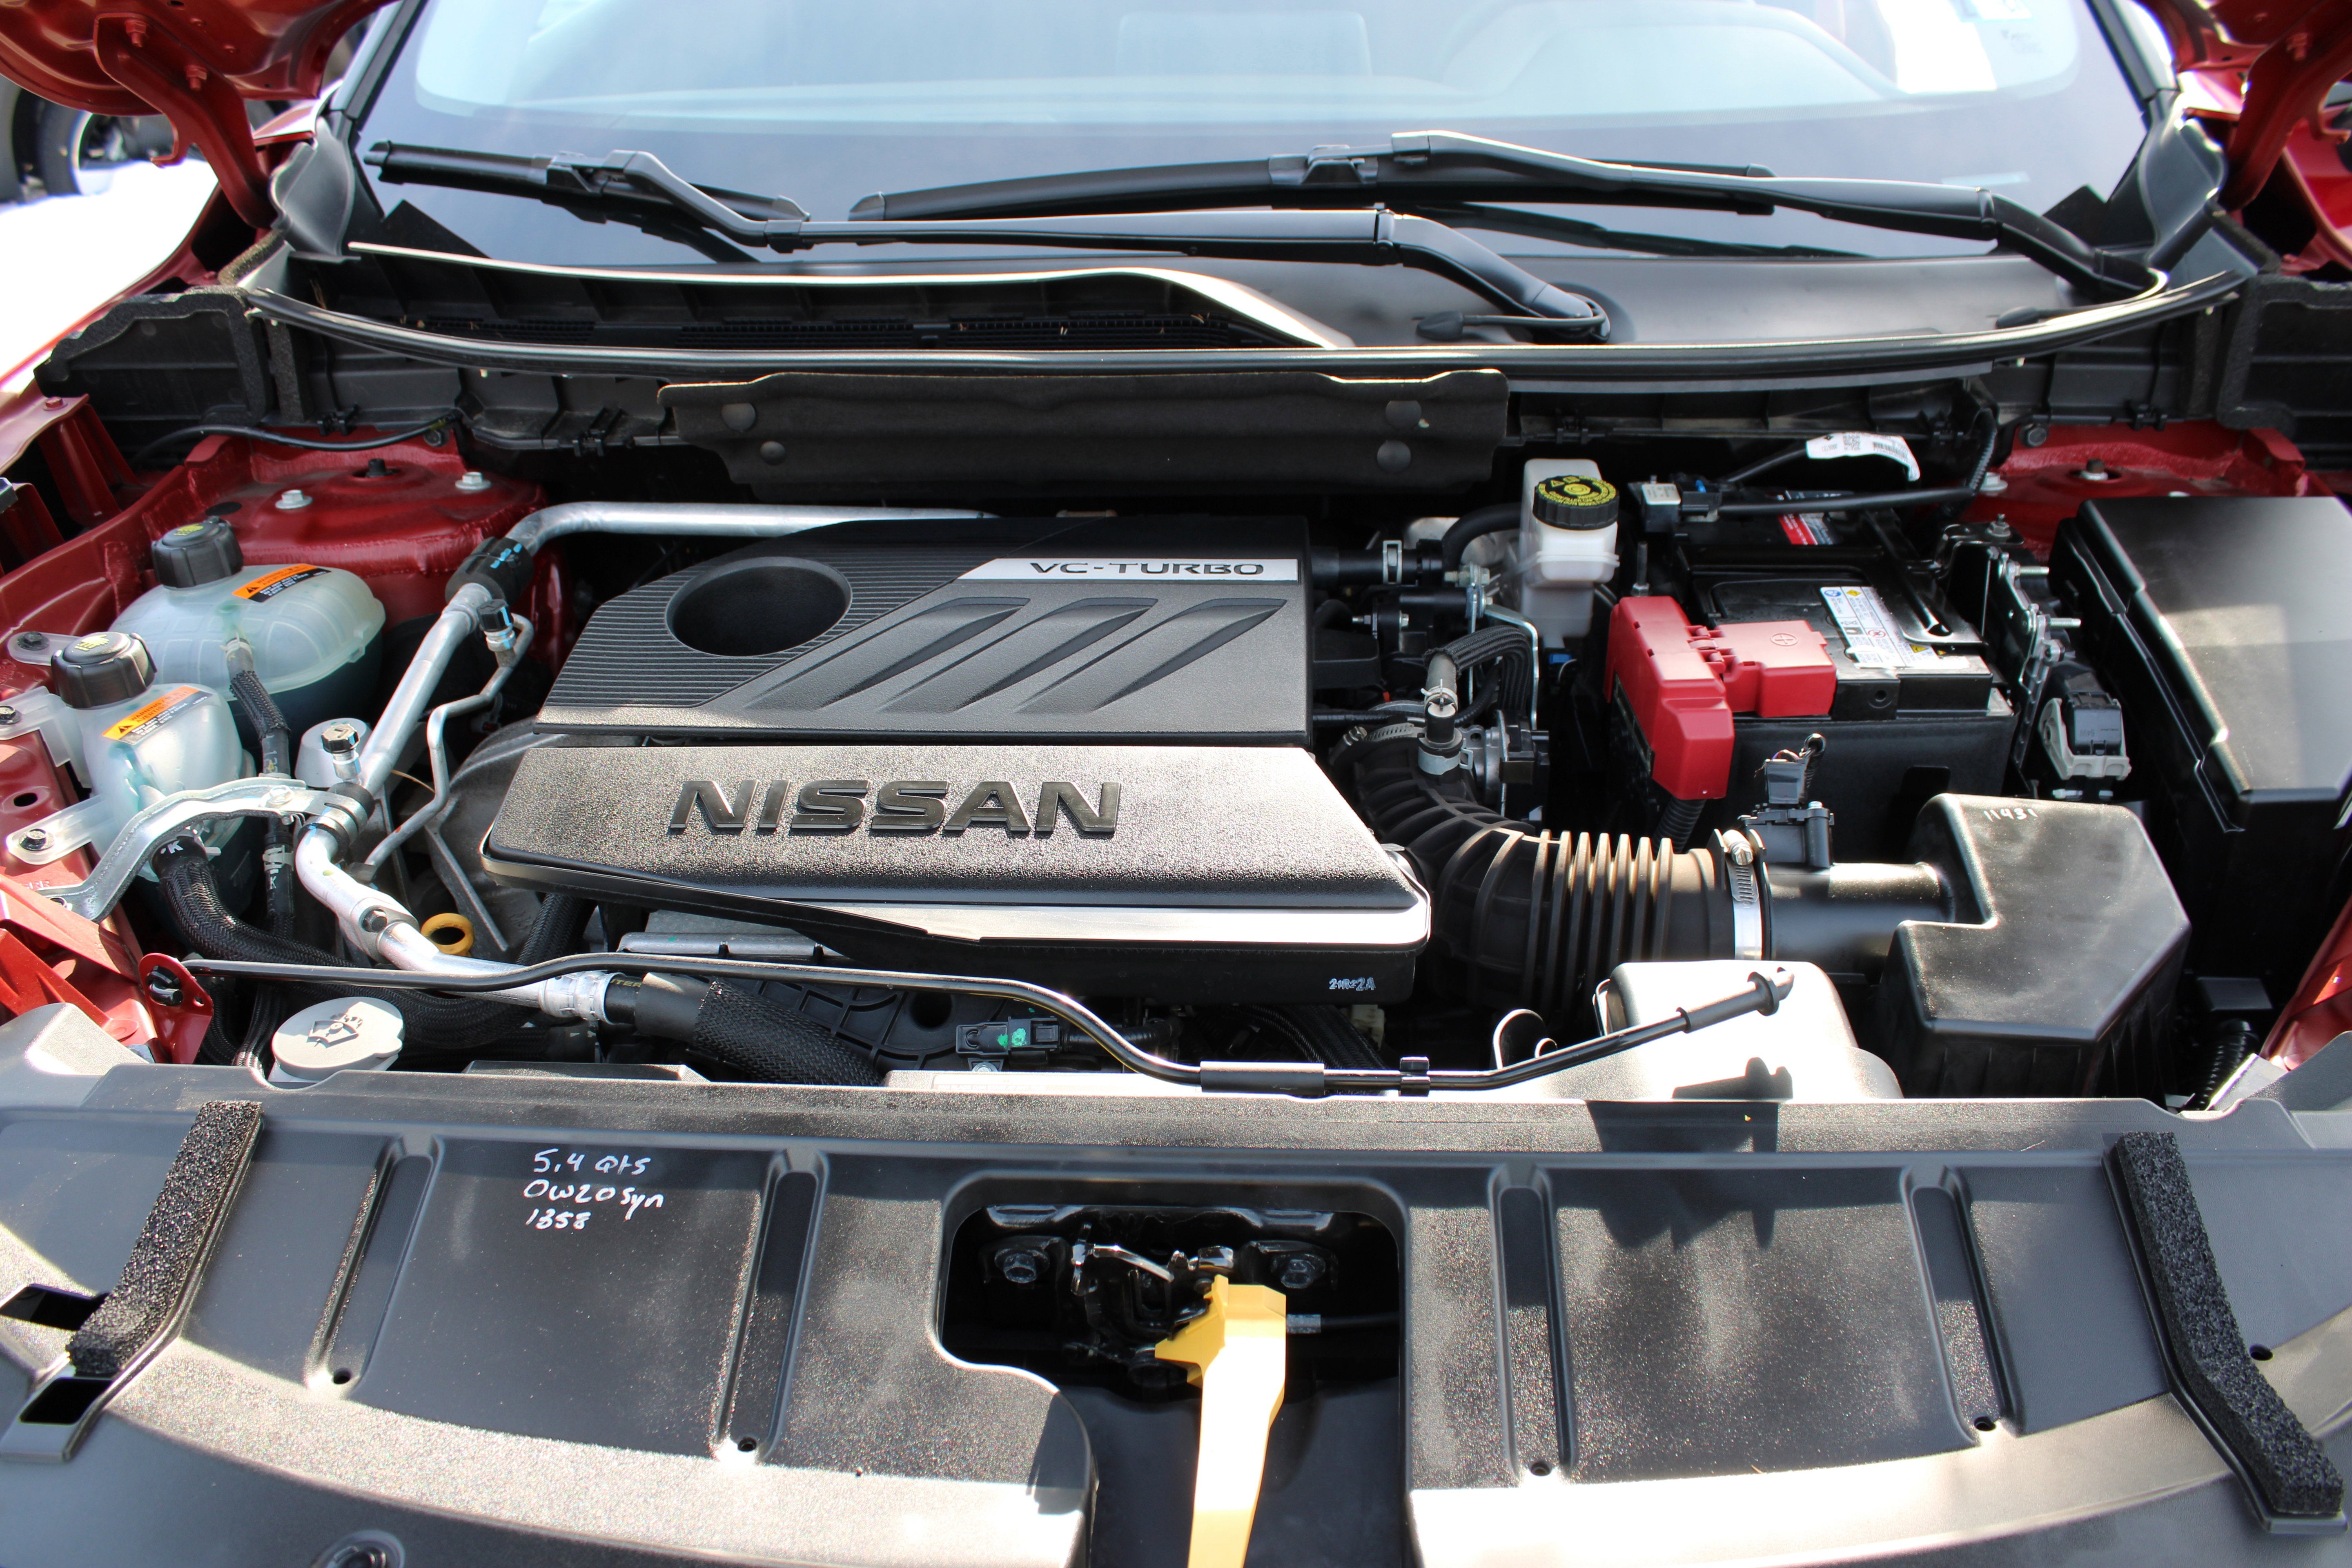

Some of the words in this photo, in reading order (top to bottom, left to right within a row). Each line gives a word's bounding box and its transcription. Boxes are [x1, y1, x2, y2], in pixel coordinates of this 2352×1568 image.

[1029, 562, 1264, 575] VC-TURBO
[129, 702, 162, 721] WARNING
[669, 780, 1121, 833] NISSAN
[525, 1207, 592, 1230] 1358
